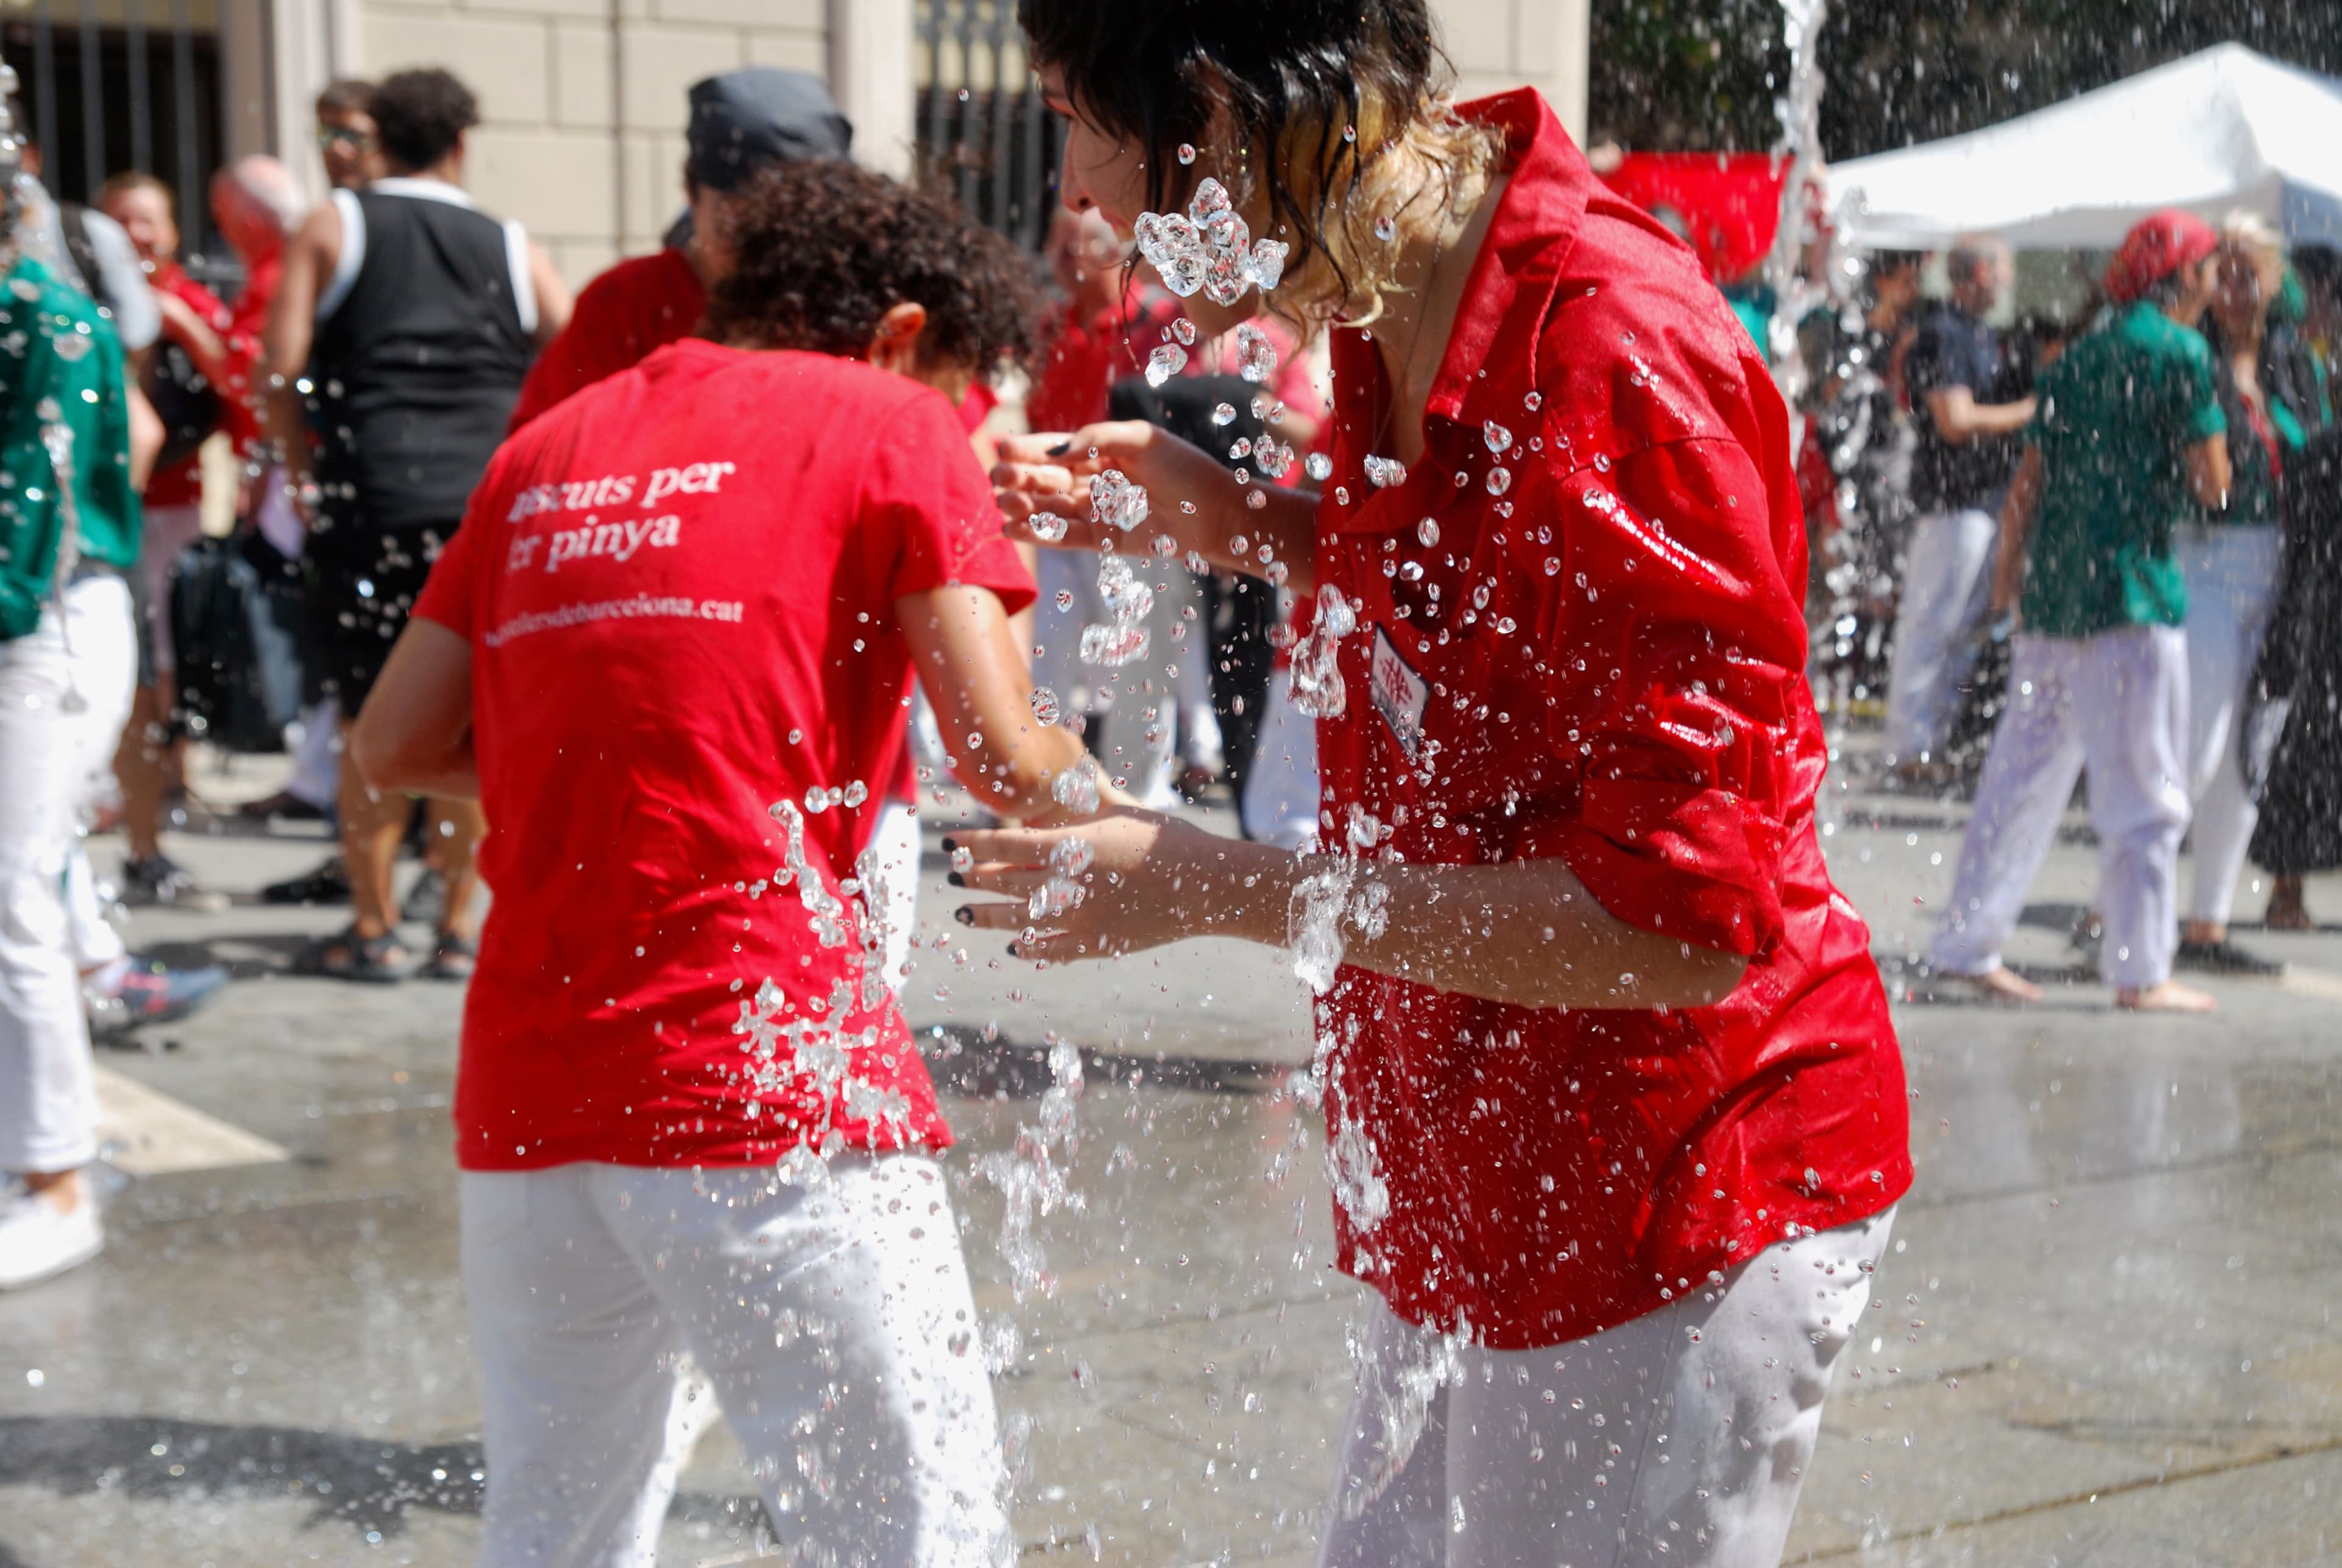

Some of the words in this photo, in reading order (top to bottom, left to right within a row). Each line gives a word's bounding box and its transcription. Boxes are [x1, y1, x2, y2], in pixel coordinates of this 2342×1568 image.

[640, 461, 736, 509] per
[506, 534, 542, 575] er
[545, 514, 681, 573] pinya
